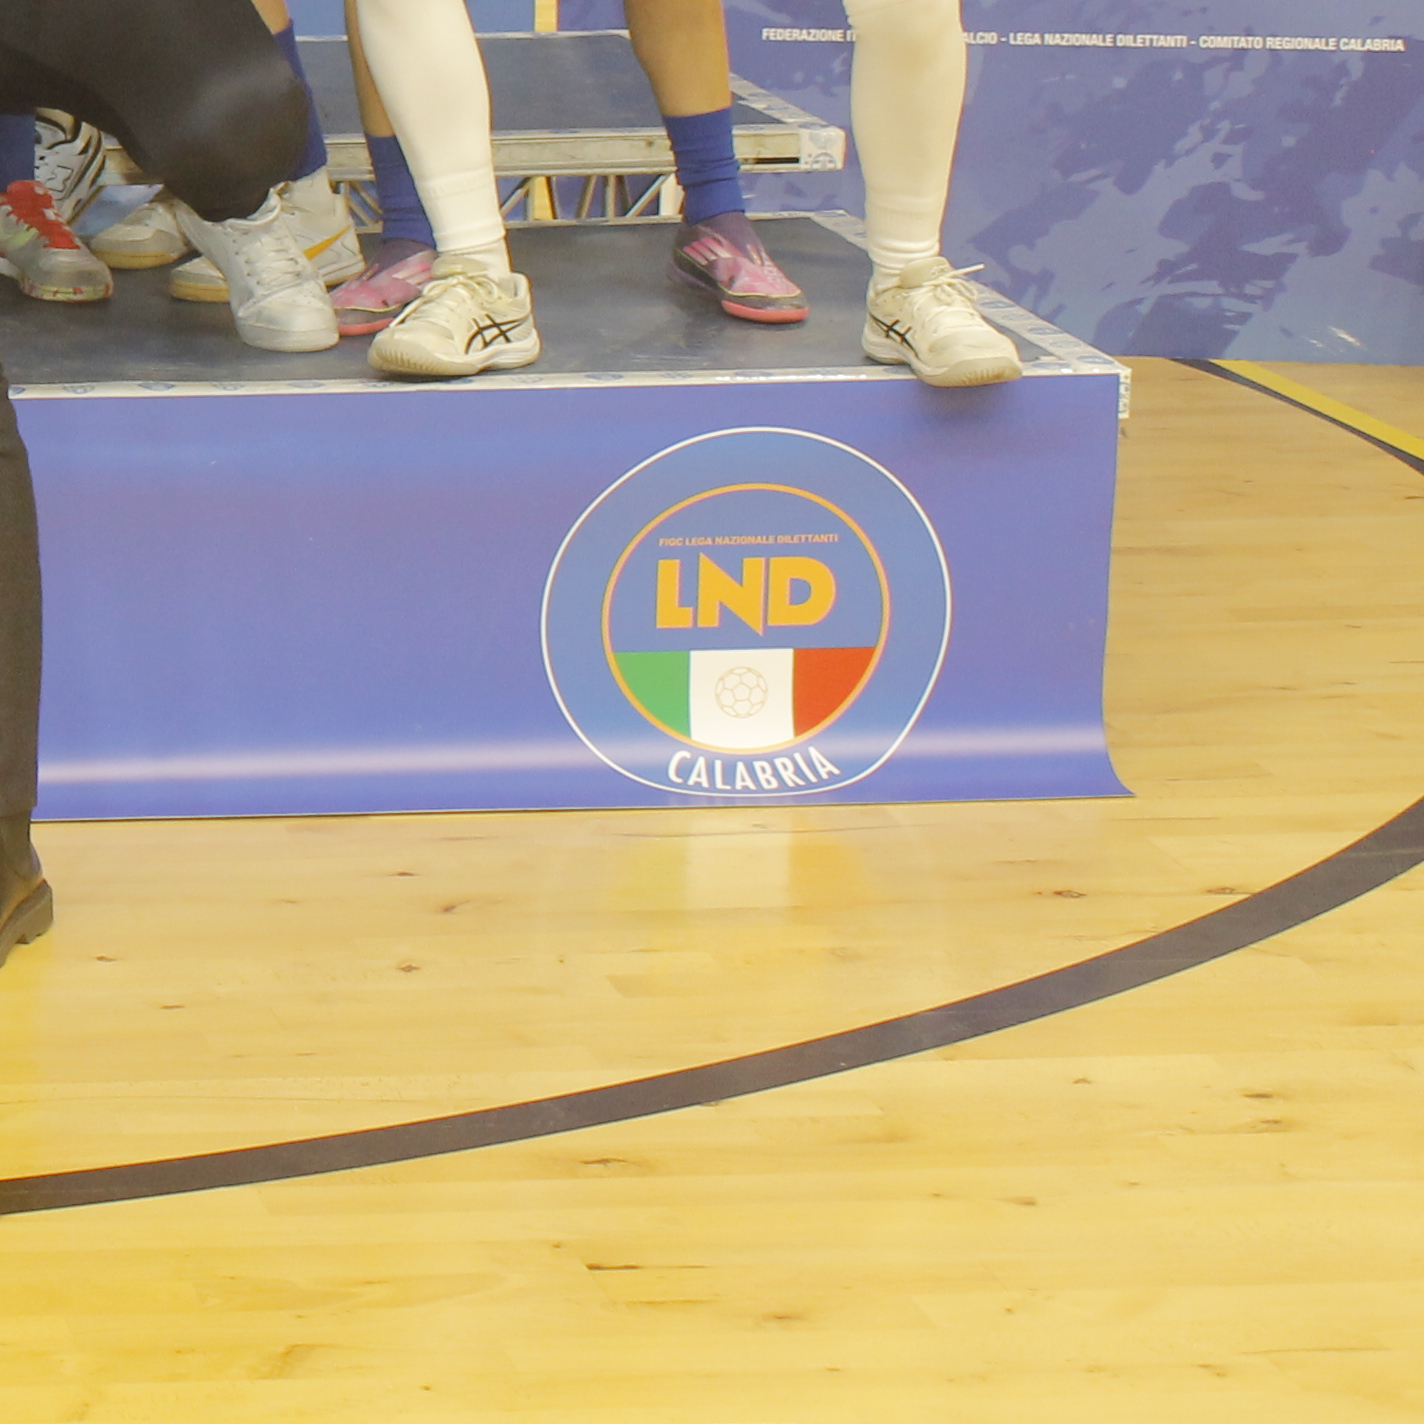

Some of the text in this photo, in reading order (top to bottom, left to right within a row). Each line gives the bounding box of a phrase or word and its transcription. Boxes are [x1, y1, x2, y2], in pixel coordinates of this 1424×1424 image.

[762, 28, 844, 42] FEDERAZIONE
[962, 32, 997, 46] ALCIO
[1009, 32, 1041, 46] LEGA
[1044, 33, 1114, 47] NAZIONALE
[1116, 34, 1189, 48] DILETTANTI
[1199, 35, 1264, 50] COMITATO
[1266, 36, 1337, 51] REGIONALE
[1339, 37, 1406, 52] CALABRIA
[658, 533, 839, 547] FIGC LEGA NAZIONALE DILETTANTI
[655, 552, 837, 636] LND
[667, 745, 842, 791] CALABRIA
